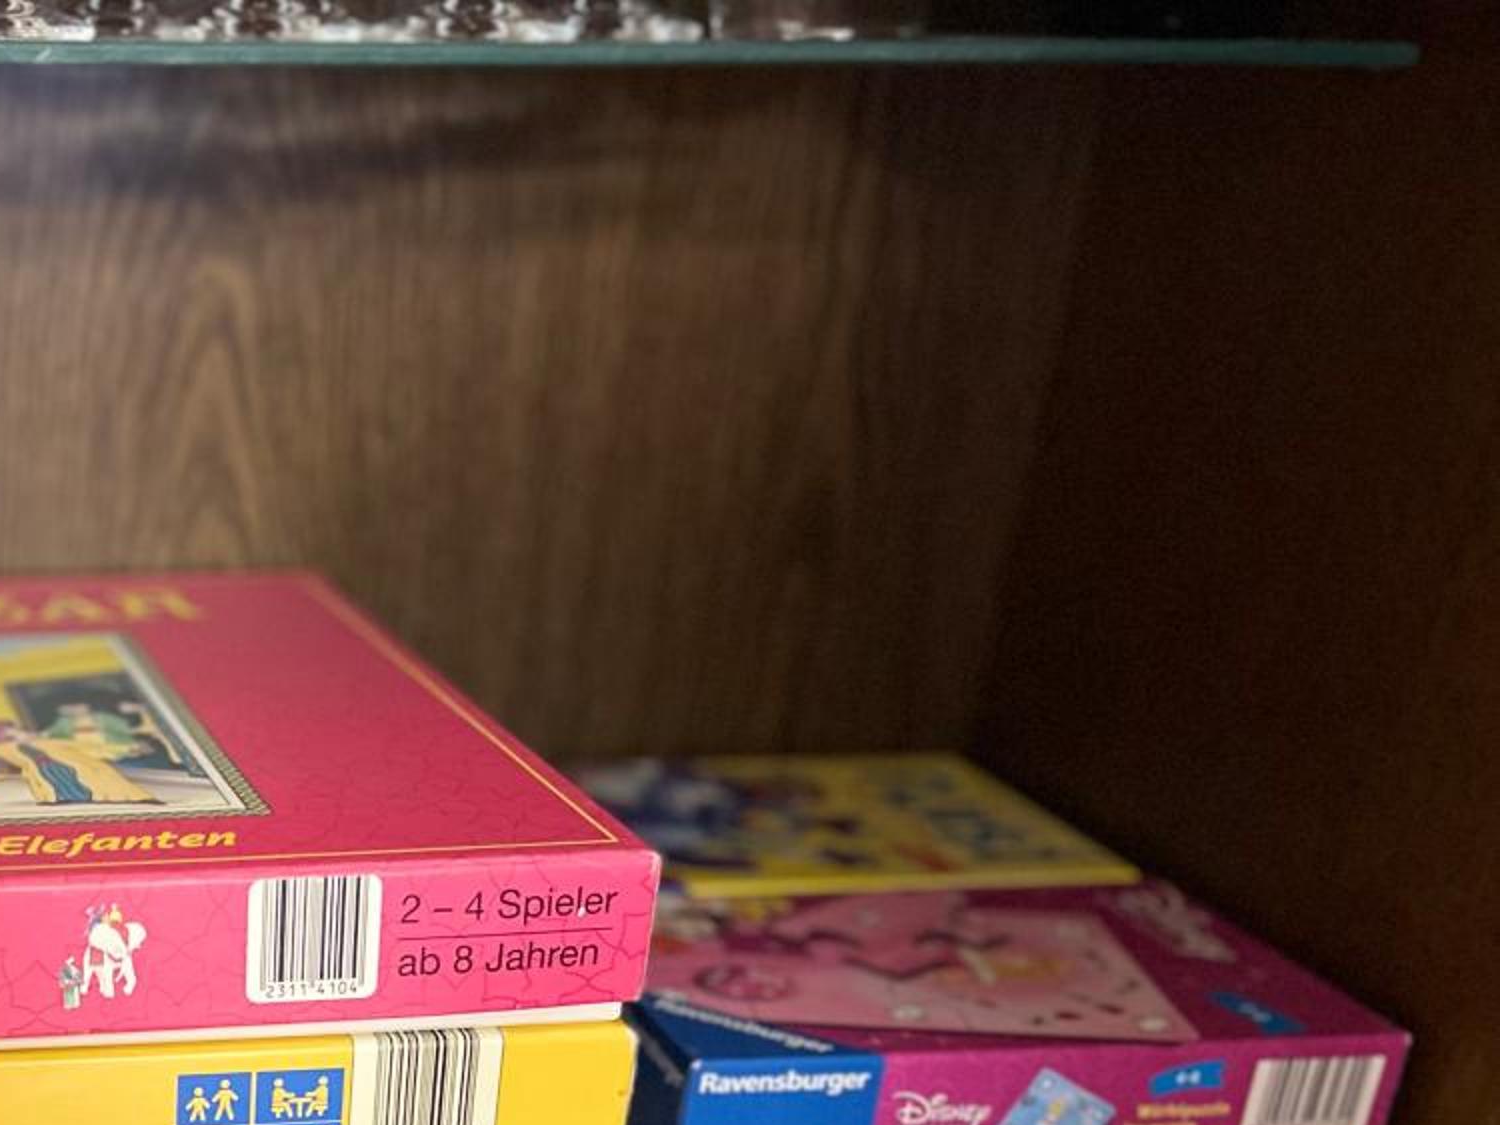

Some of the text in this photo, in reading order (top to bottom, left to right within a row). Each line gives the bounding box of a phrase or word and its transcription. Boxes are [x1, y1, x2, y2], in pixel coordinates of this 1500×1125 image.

[400, 893, 421, 923] 2
[464, 890, 485, 920] 4
[497, 885, 619, 926] Spieler
[397, 940, 599, 977] ab 8 Jahren
[699, 1070, 871, 1096] Ravensburger
